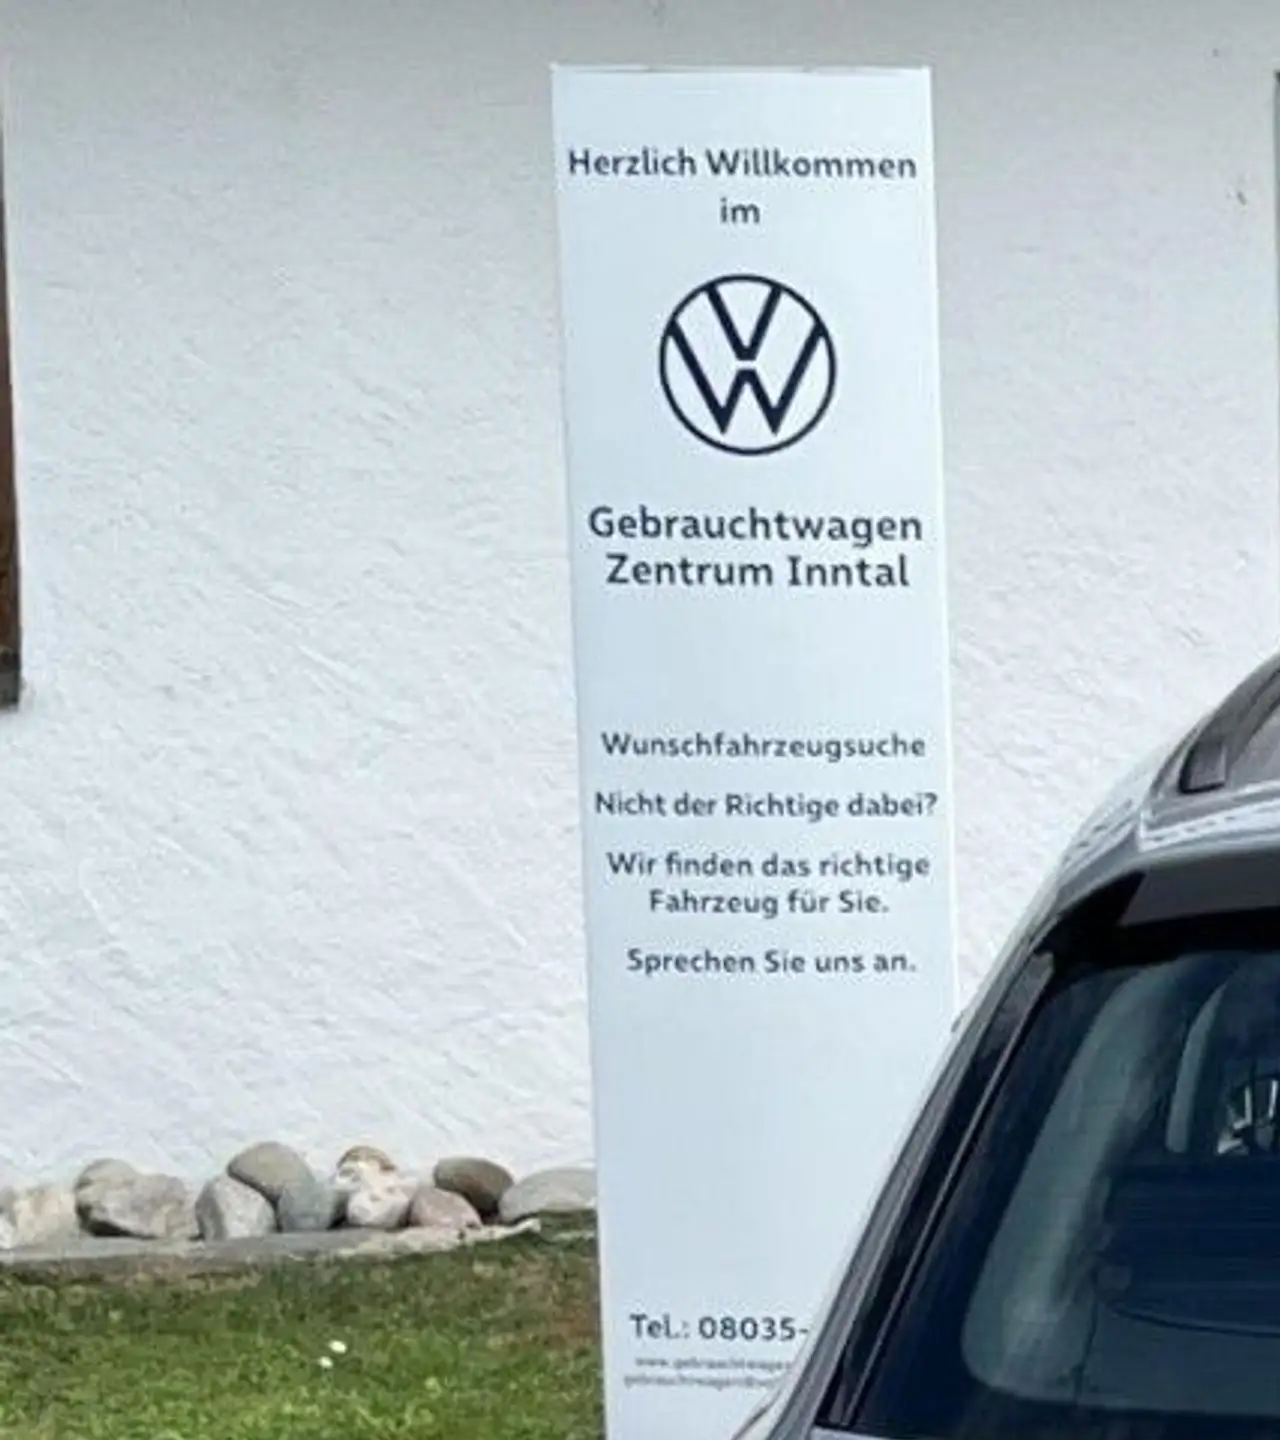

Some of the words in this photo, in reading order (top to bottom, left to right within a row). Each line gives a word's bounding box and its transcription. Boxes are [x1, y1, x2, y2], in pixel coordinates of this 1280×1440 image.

[568, 148, 696, 177] Herzlich
[706, 148, 917, 179] Willkommen
[720, 198, 760, 225] im
[588, 505, 923, 548] Gebrauchtwagen
[606, 553, 772, 586] Zentrum
[788, 554, 909, 588] Inntal
[600, 732, 926, 763] Wunschfahrzeugsuche
[595, 792, 667, 817] Nicht
[674, 793, 718, 817] der
[725, 793, 839, 822] Richtige
[848, 792, 938, 817] dabei?
[606, 852, 656, 876] Wir
[664, 852, 753, 877] finden
[761, 853, 811, 878] das
[818, 853, 931, 882] richtige
[649, 888, 779, 919] Fahrzeug
[787, 890, 829, 914] für
[838, 890, 890, 914] Sie.
[626, 949, 756, 977] Sprechen
[764, 950, 805, 974] Sie
[814, 954, 866, 974] uns
[872, 953, 916, 974] an.
[629, 1314, 690, 1340] Tel.:
[698, 1316, 809, 1341] 08035-
